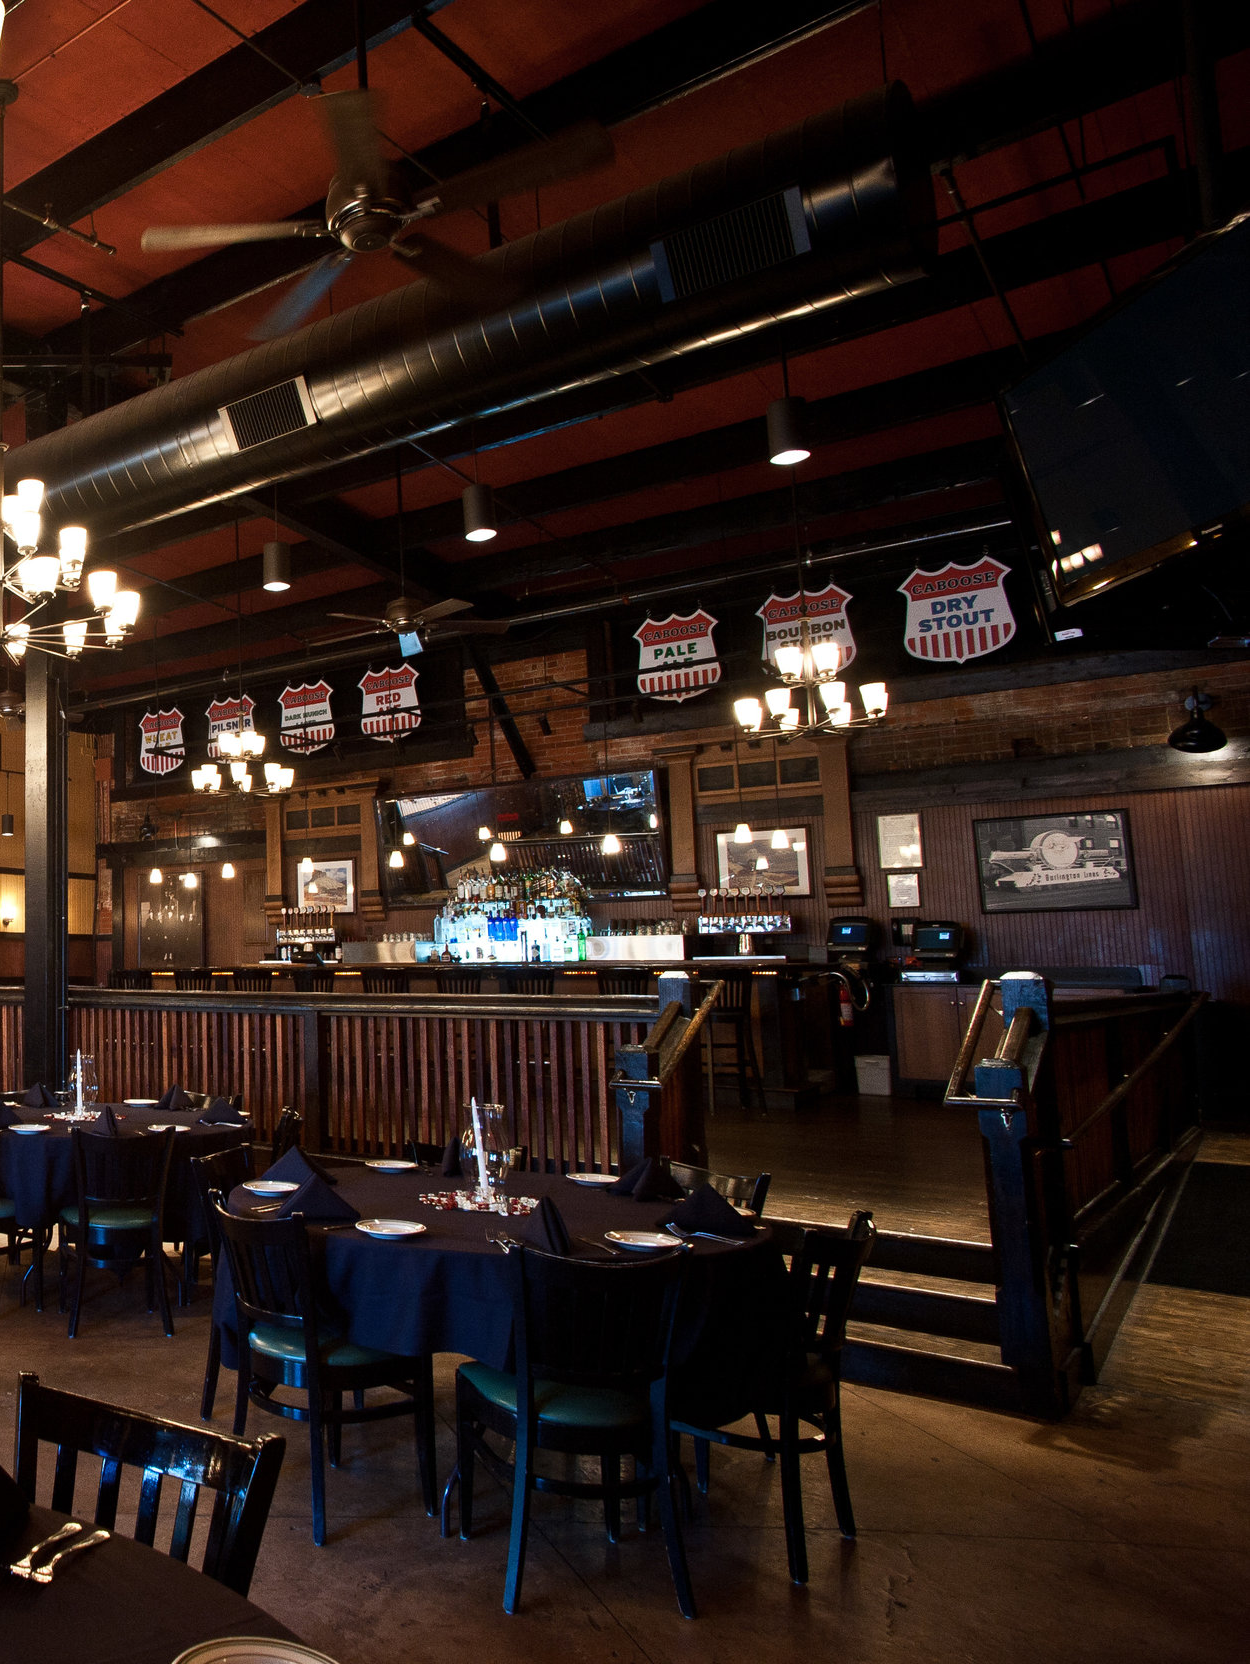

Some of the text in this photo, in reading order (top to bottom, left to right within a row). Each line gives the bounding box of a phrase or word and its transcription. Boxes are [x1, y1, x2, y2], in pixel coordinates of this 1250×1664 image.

[912, 571, 996, 595] CABOOSE
[931, 594, 978, 615] DRY
[918, 608, 995, 633] STOUT
[644, 622, 707, 642] CABOOSE
[654, 642, 697, 660] PALE
[365, 674, 410, 690] CABOOSE
[284, 691, 326, 705] CABOOSE
[376, 692, 401, 706] RED
[211, 704, 249, 718] CABOOE
[285, 709, 327, 722] DARK MUNICH
[211, 719, 251, 733] PILSNR
